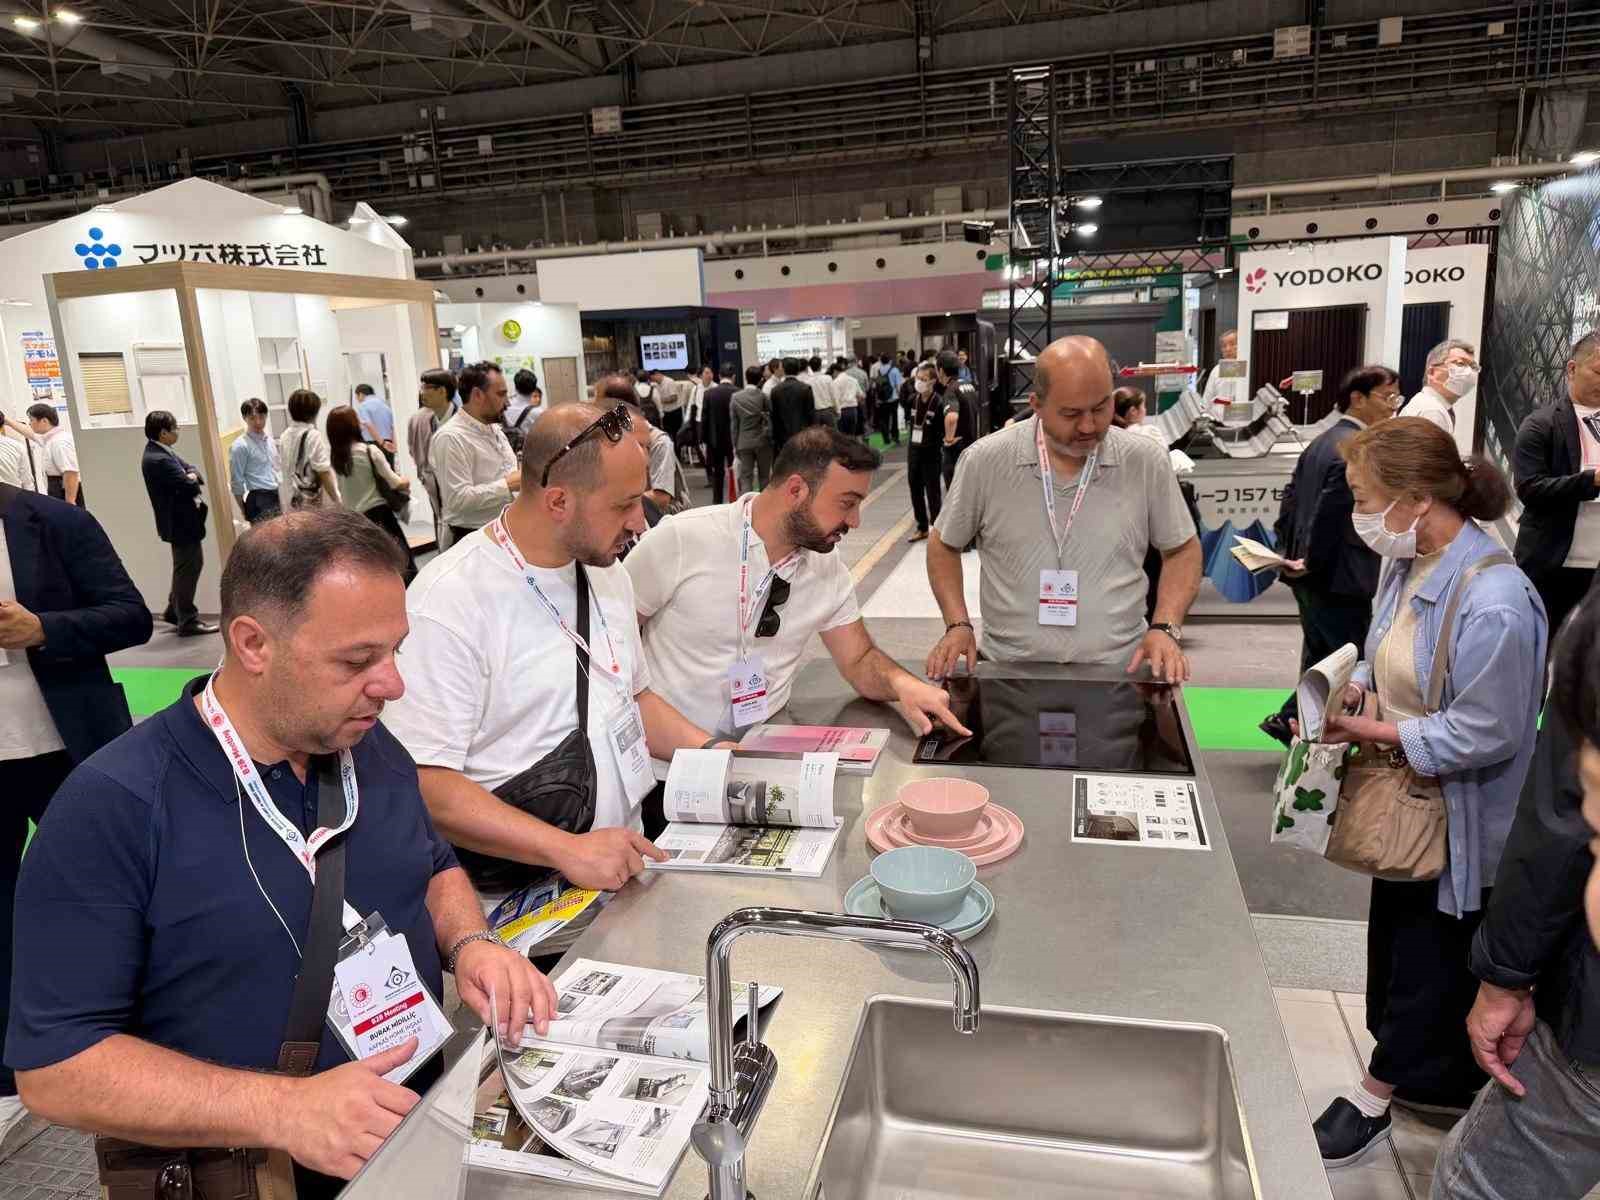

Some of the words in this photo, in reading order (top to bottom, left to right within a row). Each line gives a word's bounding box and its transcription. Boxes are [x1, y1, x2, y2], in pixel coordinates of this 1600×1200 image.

[133, 243, 327, 266] マツ六株式会社
[1273, 263, 1383, 287] YODOKO
[222, 729, 241, 759] Meeting
